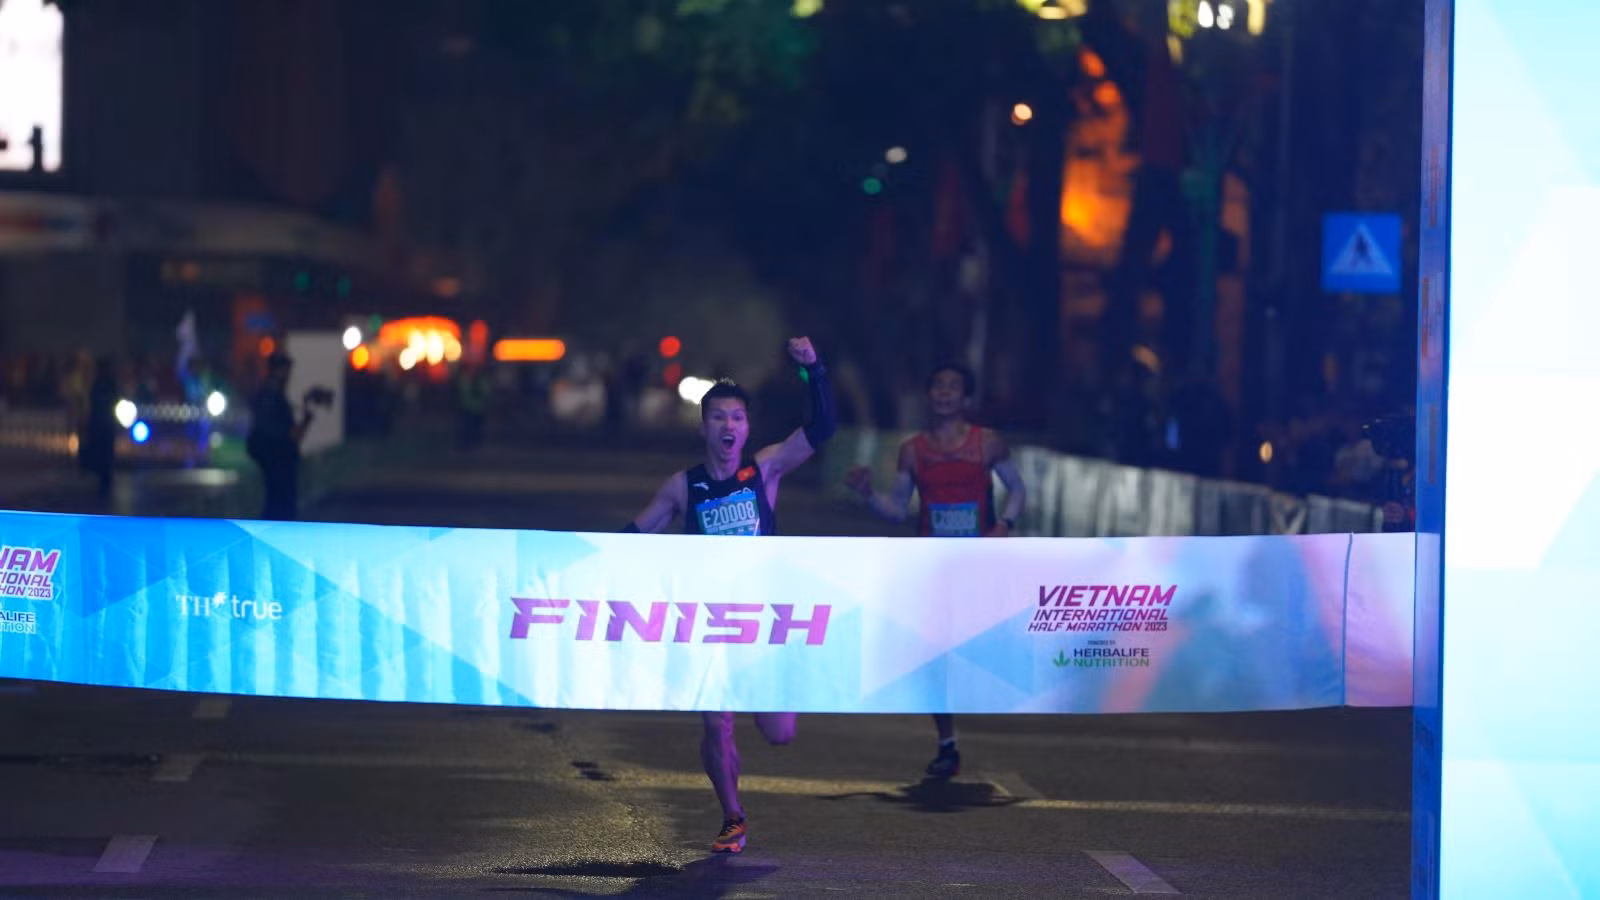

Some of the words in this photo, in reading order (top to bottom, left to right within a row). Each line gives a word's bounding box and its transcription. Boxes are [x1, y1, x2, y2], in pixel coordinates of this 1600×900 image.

[702, 500, 756, 529] E20008
[28, 587, 51, 598] 2023
[1038, 584, 1178, 607] VIETNAM
[176, 594, 211, 617] TH
[231, 594, 282, 619] true
[1033, 608, 1169, 621] INTERNATIONAL
[509, 597, 832, 646] FINISH
[1028, 622, 1065, 632] HALF
[1066, 622, 1143, 632] MARATHON
[1144, 622, 1168, 632] 2023
[1073, 648, 1150, 658] HERBALIFE
[1073, 658, 1150, 668] NUTRITION
